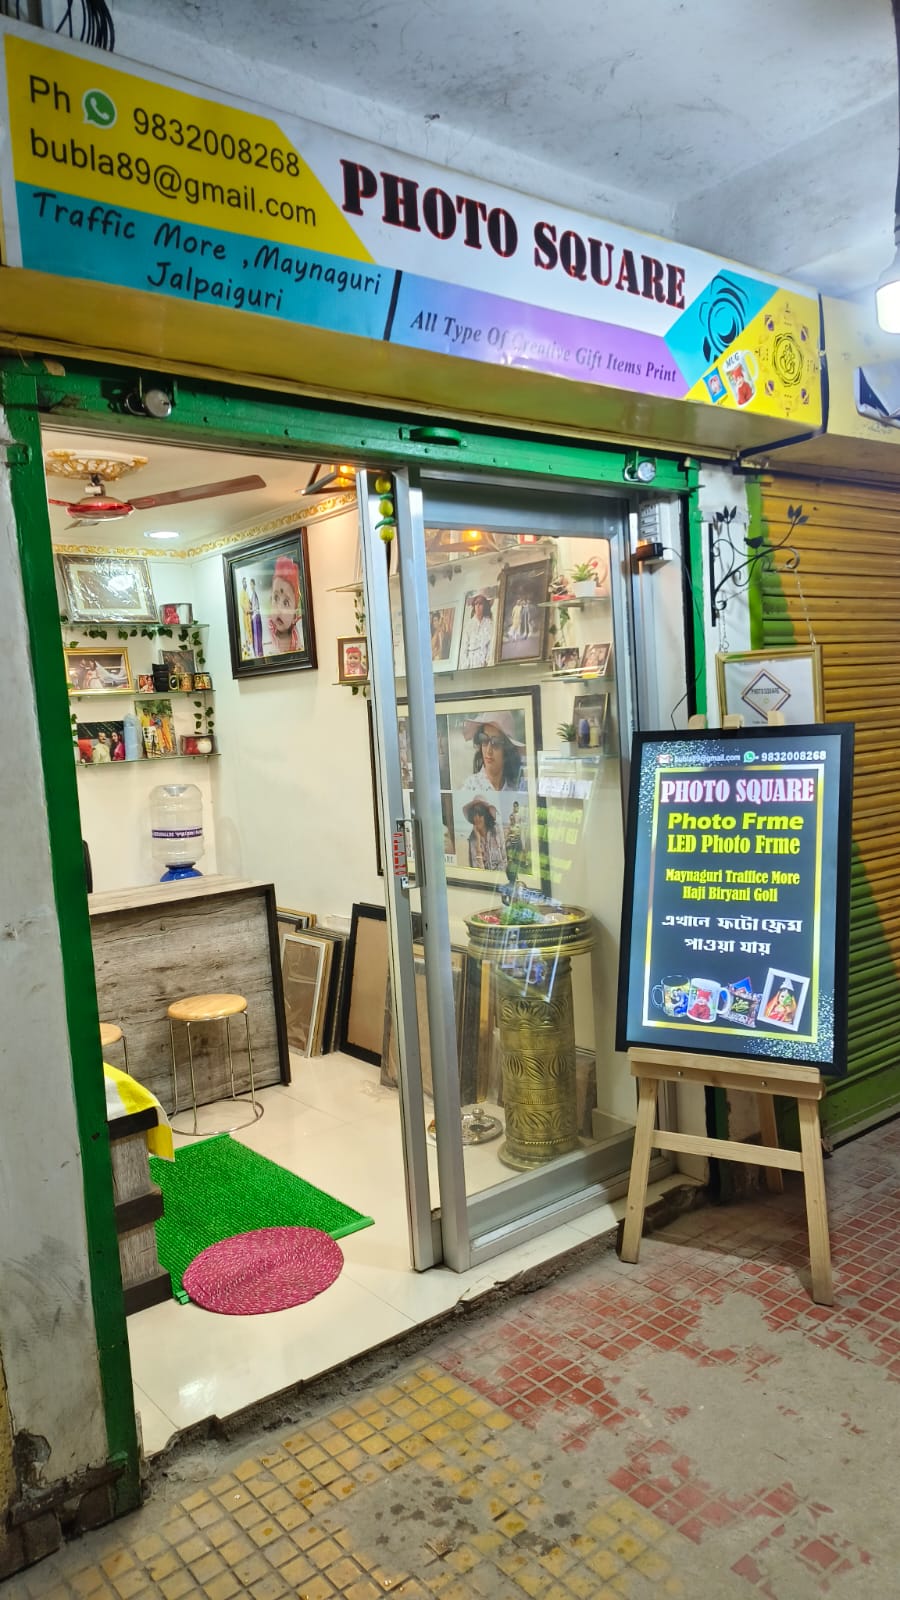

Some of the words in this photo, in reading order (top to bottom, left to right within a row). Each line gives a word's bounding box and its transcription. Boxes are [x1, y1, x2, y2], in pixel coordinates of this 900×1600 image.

[29, 74, 71, 113] Ph
[133, 107, 301, 177] 9832008268
[30, 128, 317, 227] bubla89@gmail.com
[33, 191, 136, 240] Traffic
[153, 222, 227, 261] More
[339, 158, 519, 258] PHOTO
[533, 221, 686, 310] SQUARE
[147, 260, 284, 312] Jalpaiguri
[410, 309, 438, 332] All
[444, 316, 482, 344] Type
[487, 327, 509, 349] Of
[575, 347, 602, 371] Gift
[606, 353, 641, 376] Items
[645, 361, 677, 382] Print
[761, 751, 827, 762] 9832008268
[660, 779, 731, 803] PHOTO
[735, 778, 815, 804] SQUARE
[668, 812, 737, 830] Photo
[742, 812, 804, 830] Frme
[667, 834, 697, 853] LED
[701, 834, 751, 853] Photo
[755, 835, 801, 855] Frme
[665, 868, 723, 884] Maynaguri
[771, 870, 800, 885] More
[682, 886, 706, 901] Haji
[708, 887, 751, 902] Biryani
[662, 915, 711, 928] এখানে
[716, 914, 759, 931] ফটো
[761, 918, 803, 934] ফ্রেম
[684, 937, 735, 954] পাওয়া
[739, 941, 772, 956] যায়
